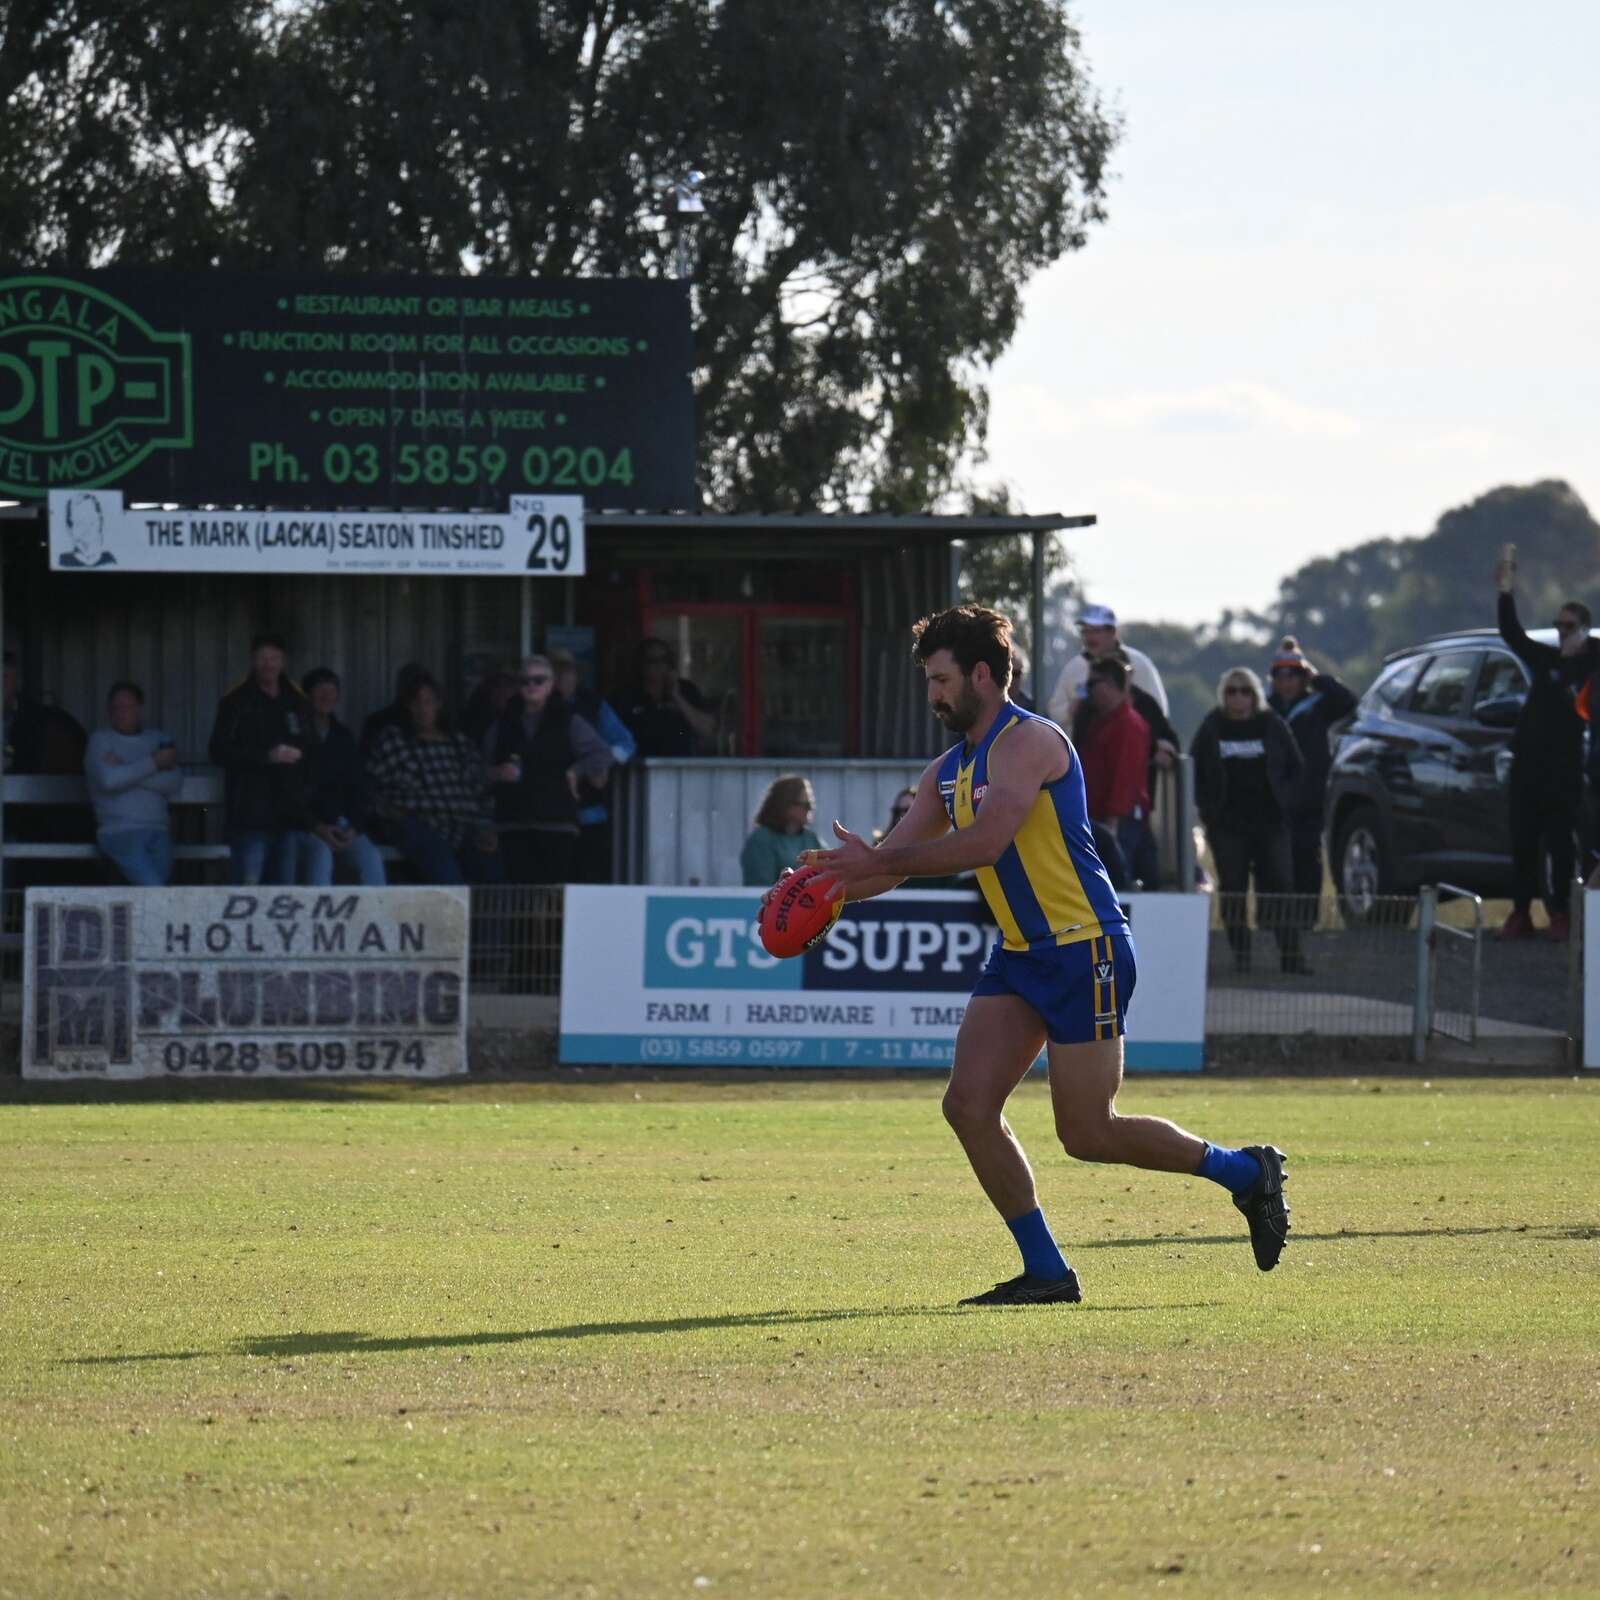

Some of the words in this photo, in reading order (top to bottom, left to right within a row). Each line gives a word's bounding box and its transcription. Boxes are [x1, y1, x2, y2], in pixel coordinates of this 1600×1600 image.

[295, 296, 420, 315] RESTAURANT
[427, 297, 456, 316] OR
[463, 298, 502, 317] BAR
[508, 298, 573, 318] MEALS
[239, 331, 344, 351] FUNCTION
[351, 333, 417, 352] ROOM
[424, 334, 464, 352] FOR
[468, 335, 500, 354] ALL
[507, 335, 629, 356] OCCASIONS
[285, 370, 480, 390] ACCOMMODATION
[485, 372, 586, 392] AVAILABLE
[328, 408, 385, 426] OPEN
[392, 409, 403, 426] 7
[411, 409, 465, 427] DAYS
[469, 410, 484, 428] A
[492, 410, 545, 429] WEEK
[49, 429, 139, 483] MOTEL
[250, 442, 309, 482] Ph.
[323, 443, 380, 484] 03
[398, 444, 507, 485] 5859
[522, 445, 634, 487] 0204
[146, 520, 184, 547] THE
[190, 520, 249, 548] MARK
[255, 521, 335, 553] (LACKA)
[338, 522, 414, 549] SEATON
[419, 523, 505, 550] TINSHED
[526, 513, 571, 571] 29
[166, 922, 425, 953] HOLYMAN
[137, 968, 461, 1028] PLUMBING
[646, 1003, 710, 1023] FARM
[746, 1005, 874, 1025] HARDWARE
[164, 1041, 260, 1072] 0428
[276, 1041, 346, 1072] 509
[355, 1040, 426, 1071] 574
[640, 1038, 682, 1060] (03)
[687, 1039, 741, 1058] 5859
[749, 1040, 804, 1059] 0597
